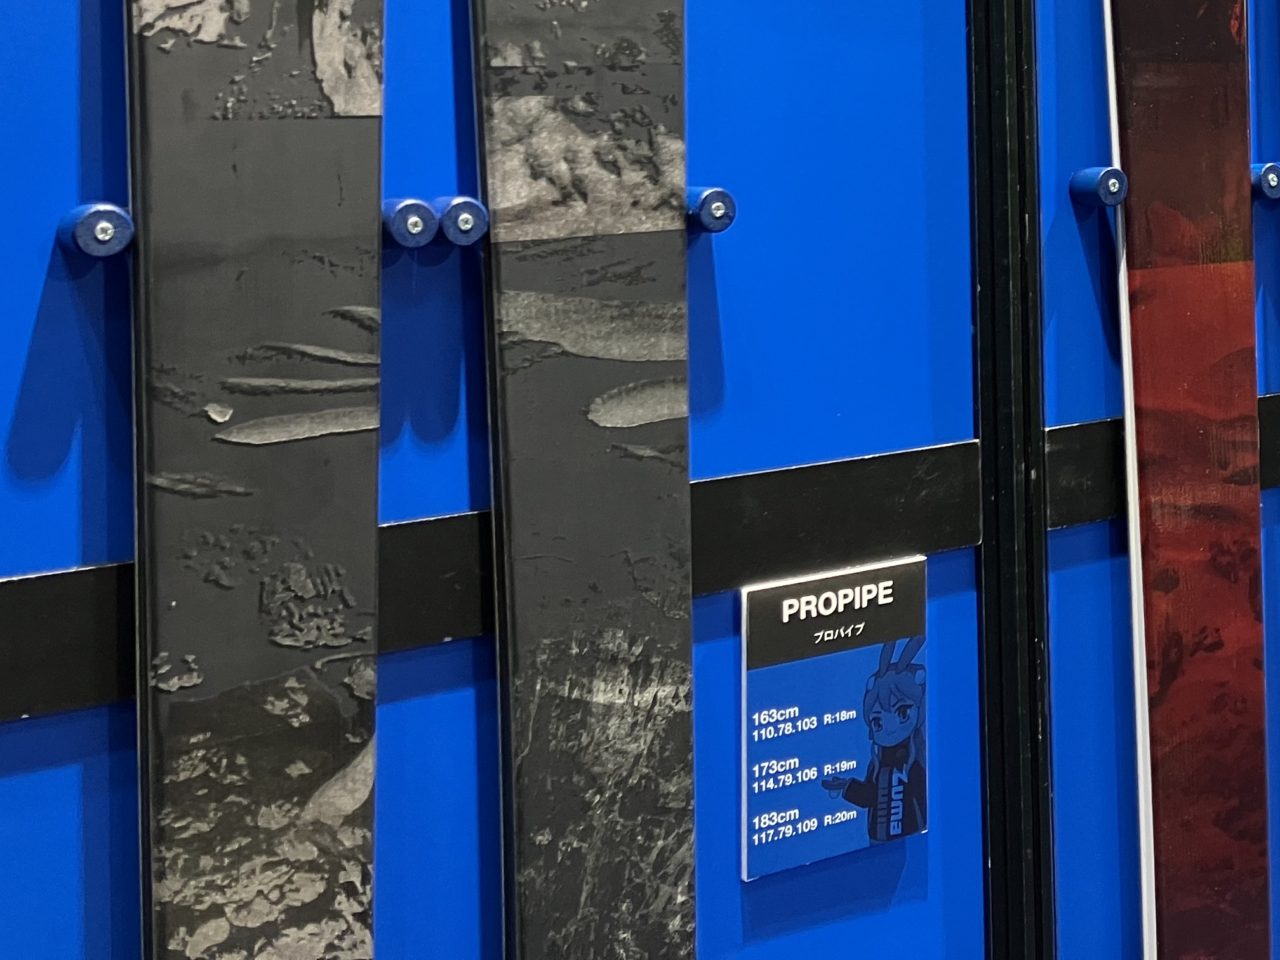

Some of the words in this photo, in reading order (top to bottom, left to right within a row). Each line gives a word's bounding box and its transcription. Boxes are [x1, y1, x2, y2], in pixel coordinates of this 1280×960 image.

[782, 580, 894, 623] PROPIPE
[813, 622, 865, 643] プロパイプ
[752, 705, 799, 726] 163cm
[752, 717, 817, 742] 110.78.103
[824, 708, 856, 725] R:18m
[752, 756, 799, 778] 173cm
[752, 768, 817, 794] 114.79.106
[824, 759, 857, 776] R:19m
[752, 807, 799, 829] 183cm
[752, 819, 818, 846] 117.79.109
[824, 809, 857, 826] R:20m
